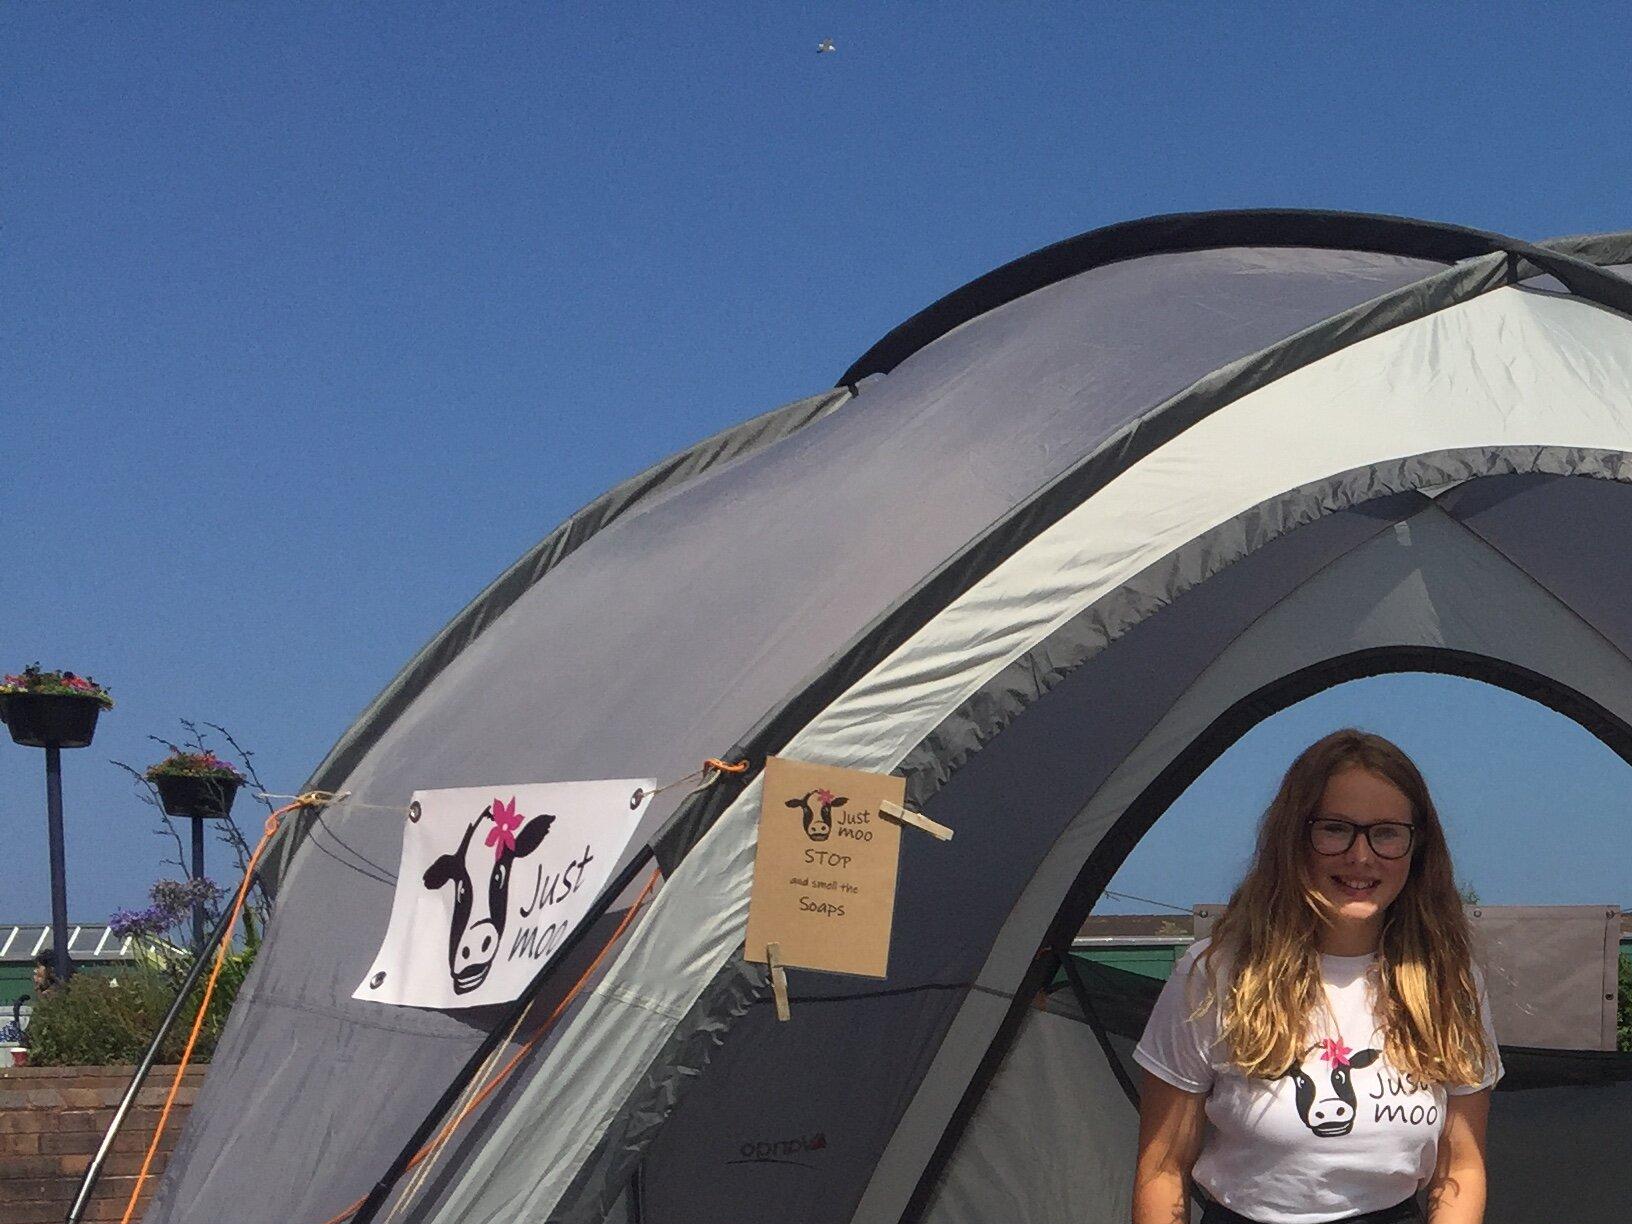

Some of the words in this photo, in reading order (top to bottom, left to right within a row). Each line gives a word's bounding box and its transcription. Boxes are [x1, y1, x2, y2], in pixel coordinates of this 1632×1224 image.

[837, 809, 871, 825] Just
[838, 827, 873, 842] moo
[804, 848, 852, 869] STOP
[519, 844, 594, 918] Just
[789, 877, 809, 887] and
[811, 880, 838, 891] smell
[840, 883, 859, 894] the
[799, 896, 846, 917] Soaps
[507, 919, 568, 962] moo
[1374, 1103, 1438, 1126] moo
